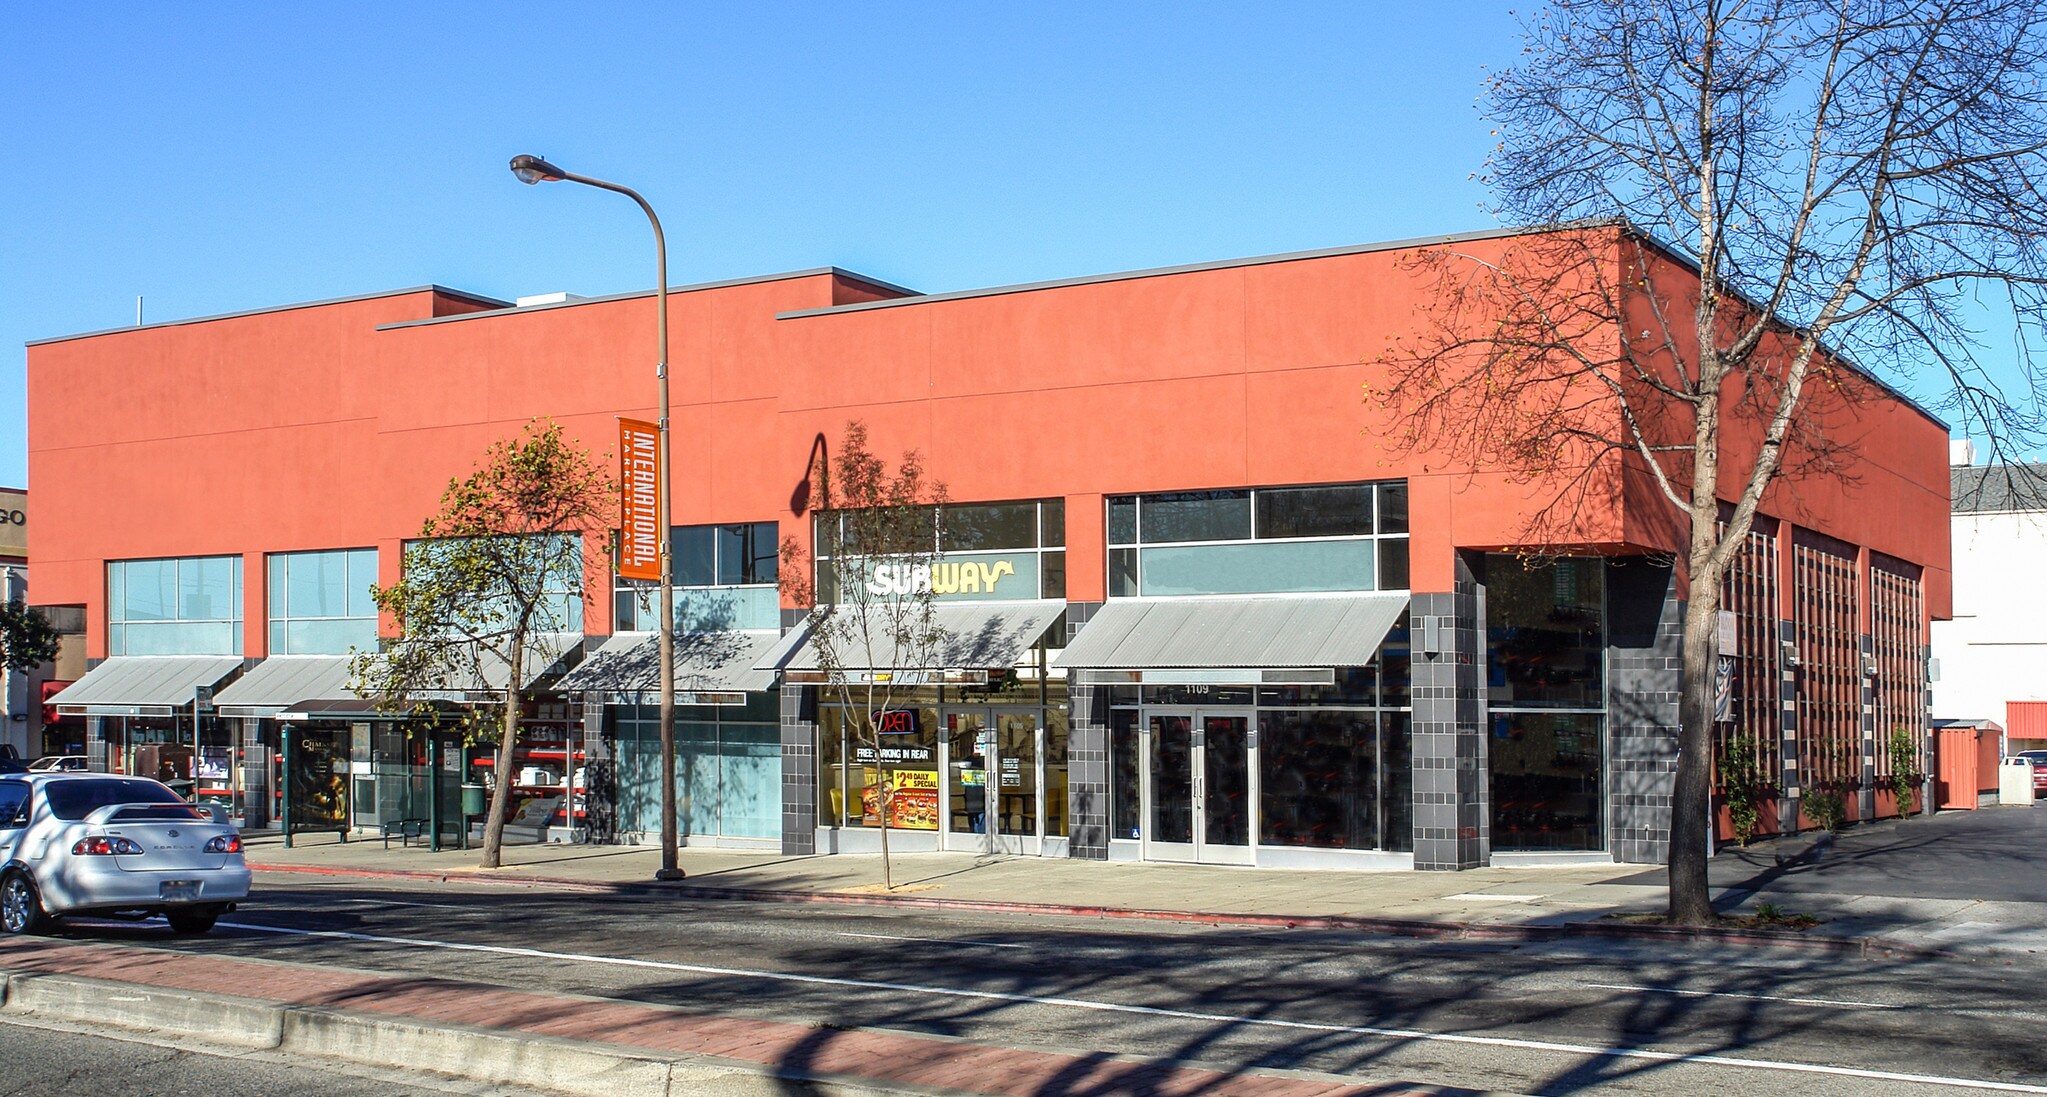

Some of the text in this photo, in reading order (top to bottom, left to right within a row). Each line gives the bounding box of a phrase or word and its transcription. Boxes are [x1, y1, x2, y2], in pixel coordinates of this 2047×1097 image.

[623, 430, 631, 565] MARKETPLACE
[633, 431, 656, 567] INTERNATIONAL
[866, 560, 1014, 596] SUBWAY
[862, 673, 893, 682] WAY
[1185, 685, 1209, 694] 1109
[872, 712, 912, 732] OPEN
[857, 748, 929, 759] FREE ARKING IN REAR
[914, 773, 930, 781] DAILY
[913, 780, 937, 788] SPECIAL
